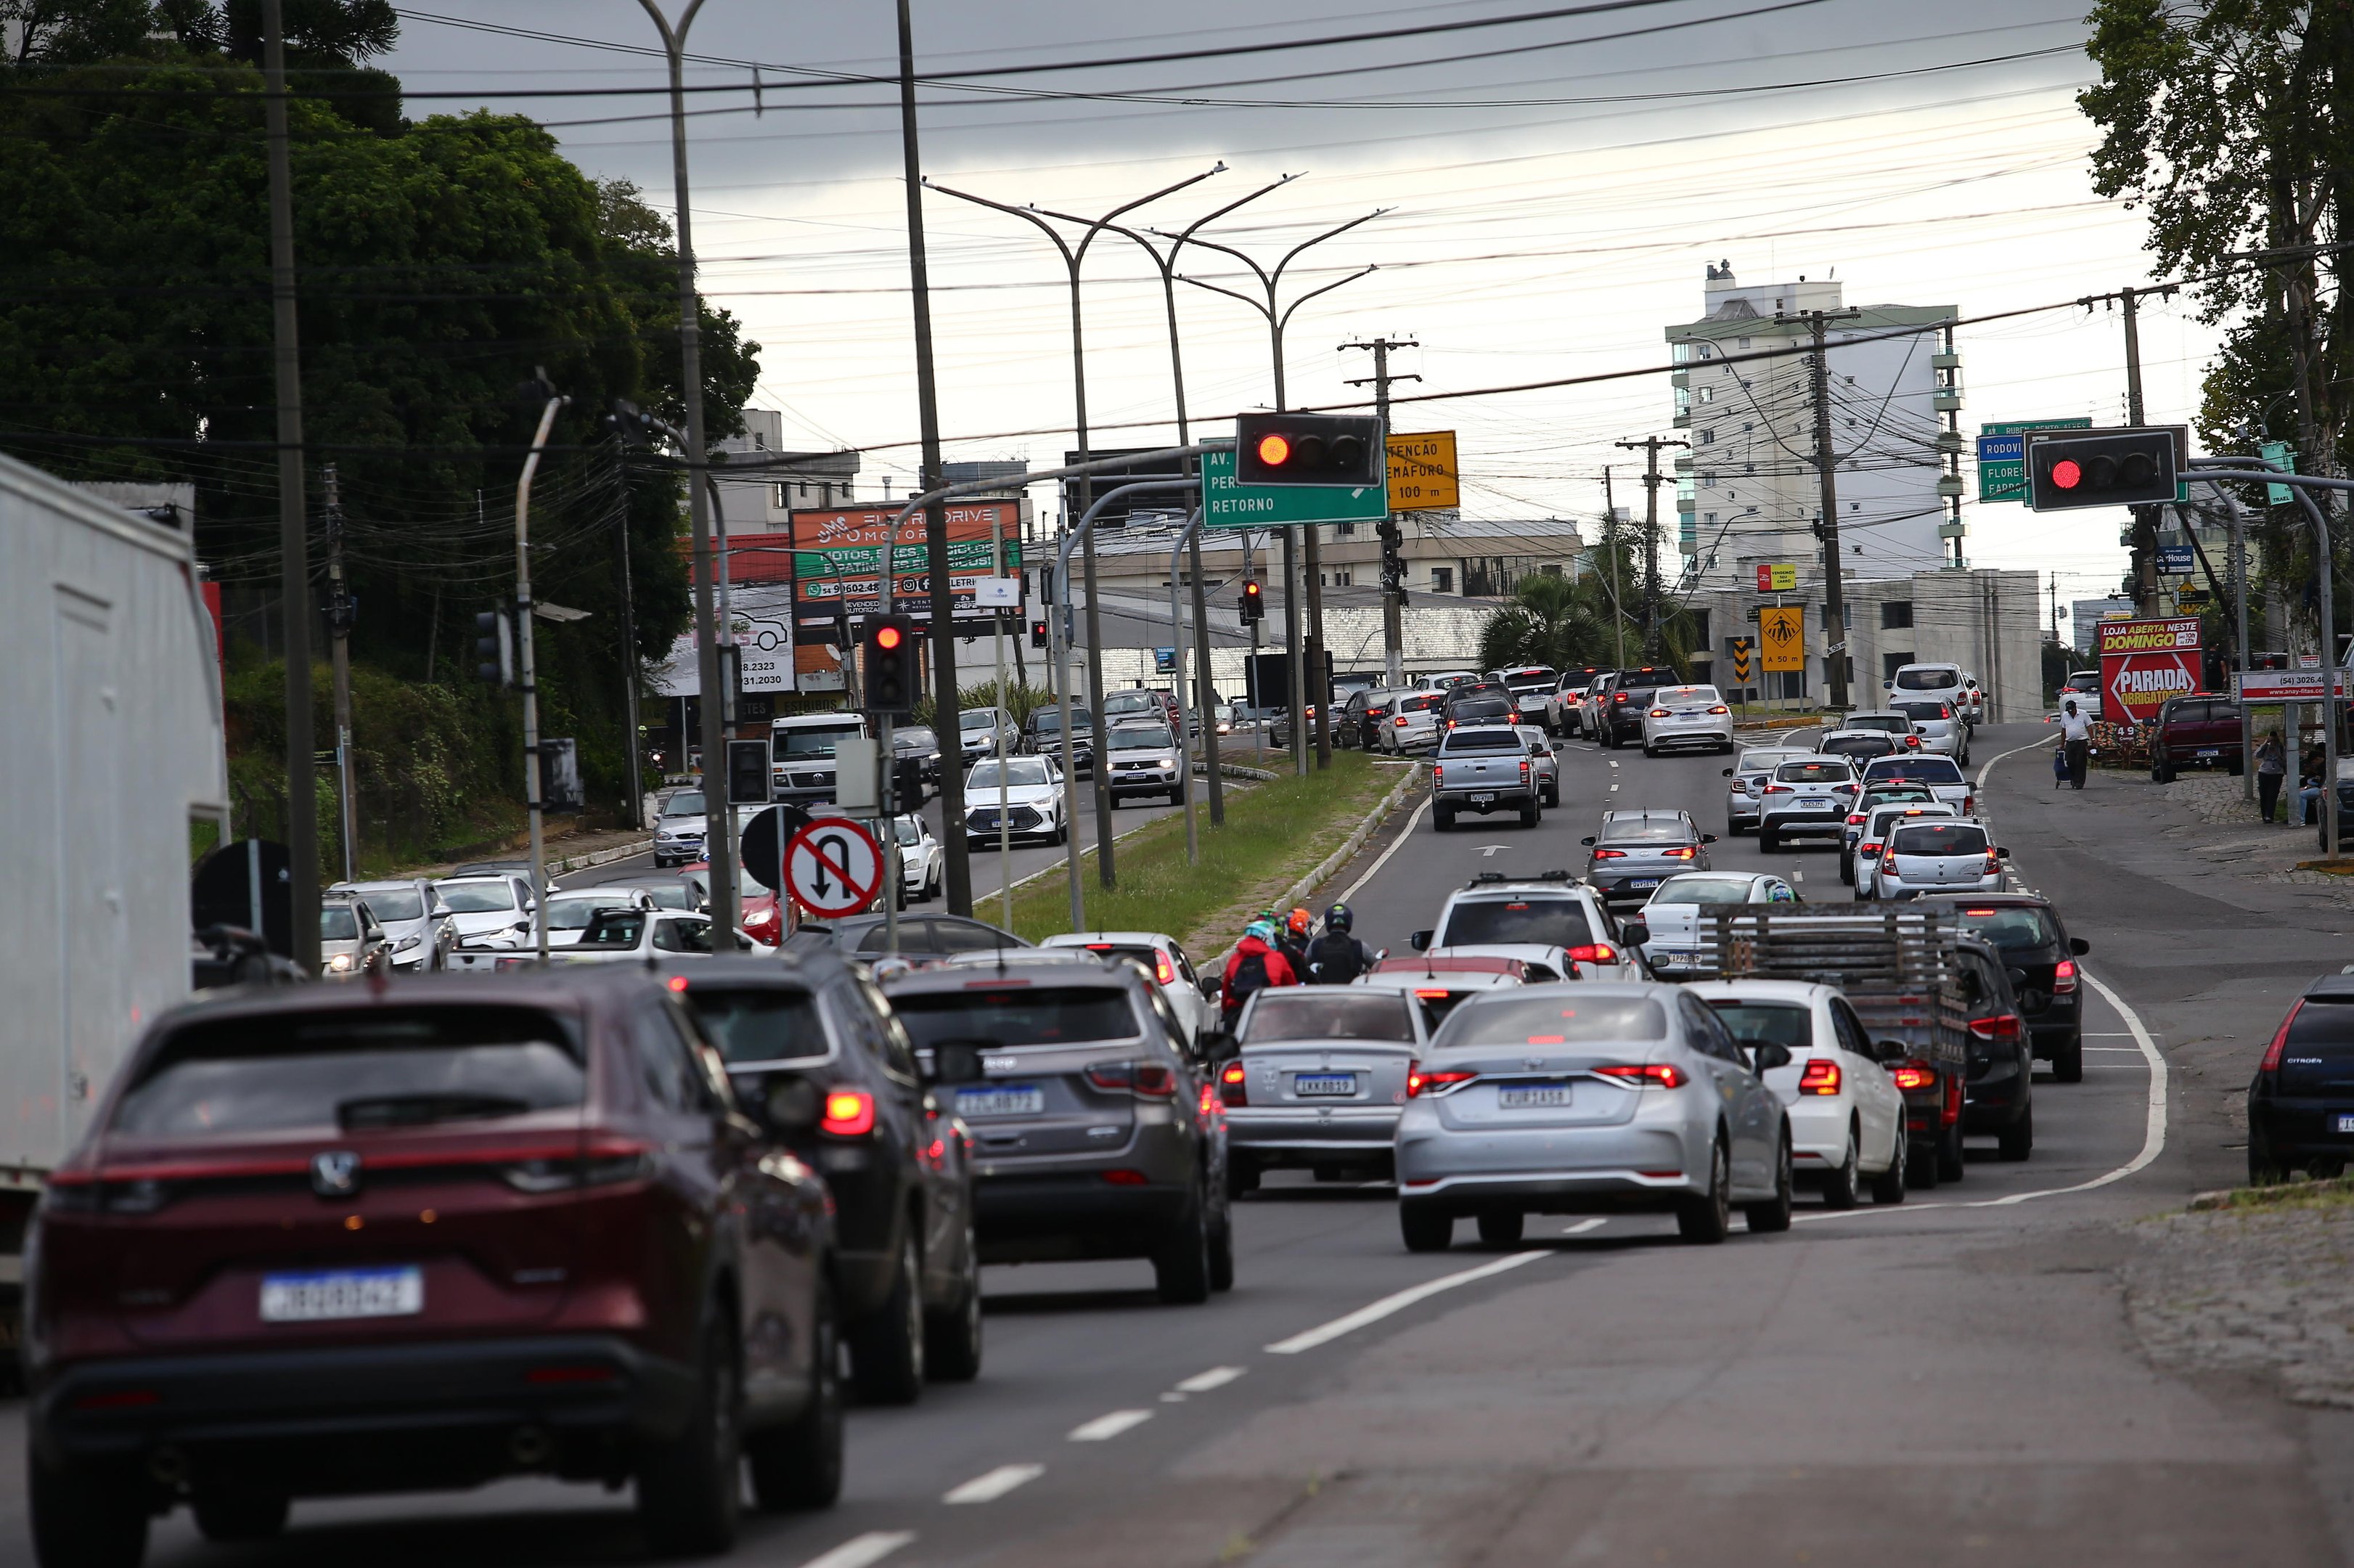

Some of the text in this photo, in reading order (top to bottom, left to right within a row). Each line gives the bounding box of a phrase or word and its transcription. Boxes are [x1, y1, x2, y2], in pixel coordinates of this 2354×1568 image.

[1210, 452, 1230, 465] AV.
[1387, 461, 1444, 478] EMÁFORO
[1399, 486, 1439, 498] 100 m
[1212, 498, 1274, 513] RETORNO
[2103, 622, 2197, 636] LOJA ABERTA NESTE
[2104, 633, 2175, 650] DOMINGO
[2120, 668, 2188, 693] PARADA
